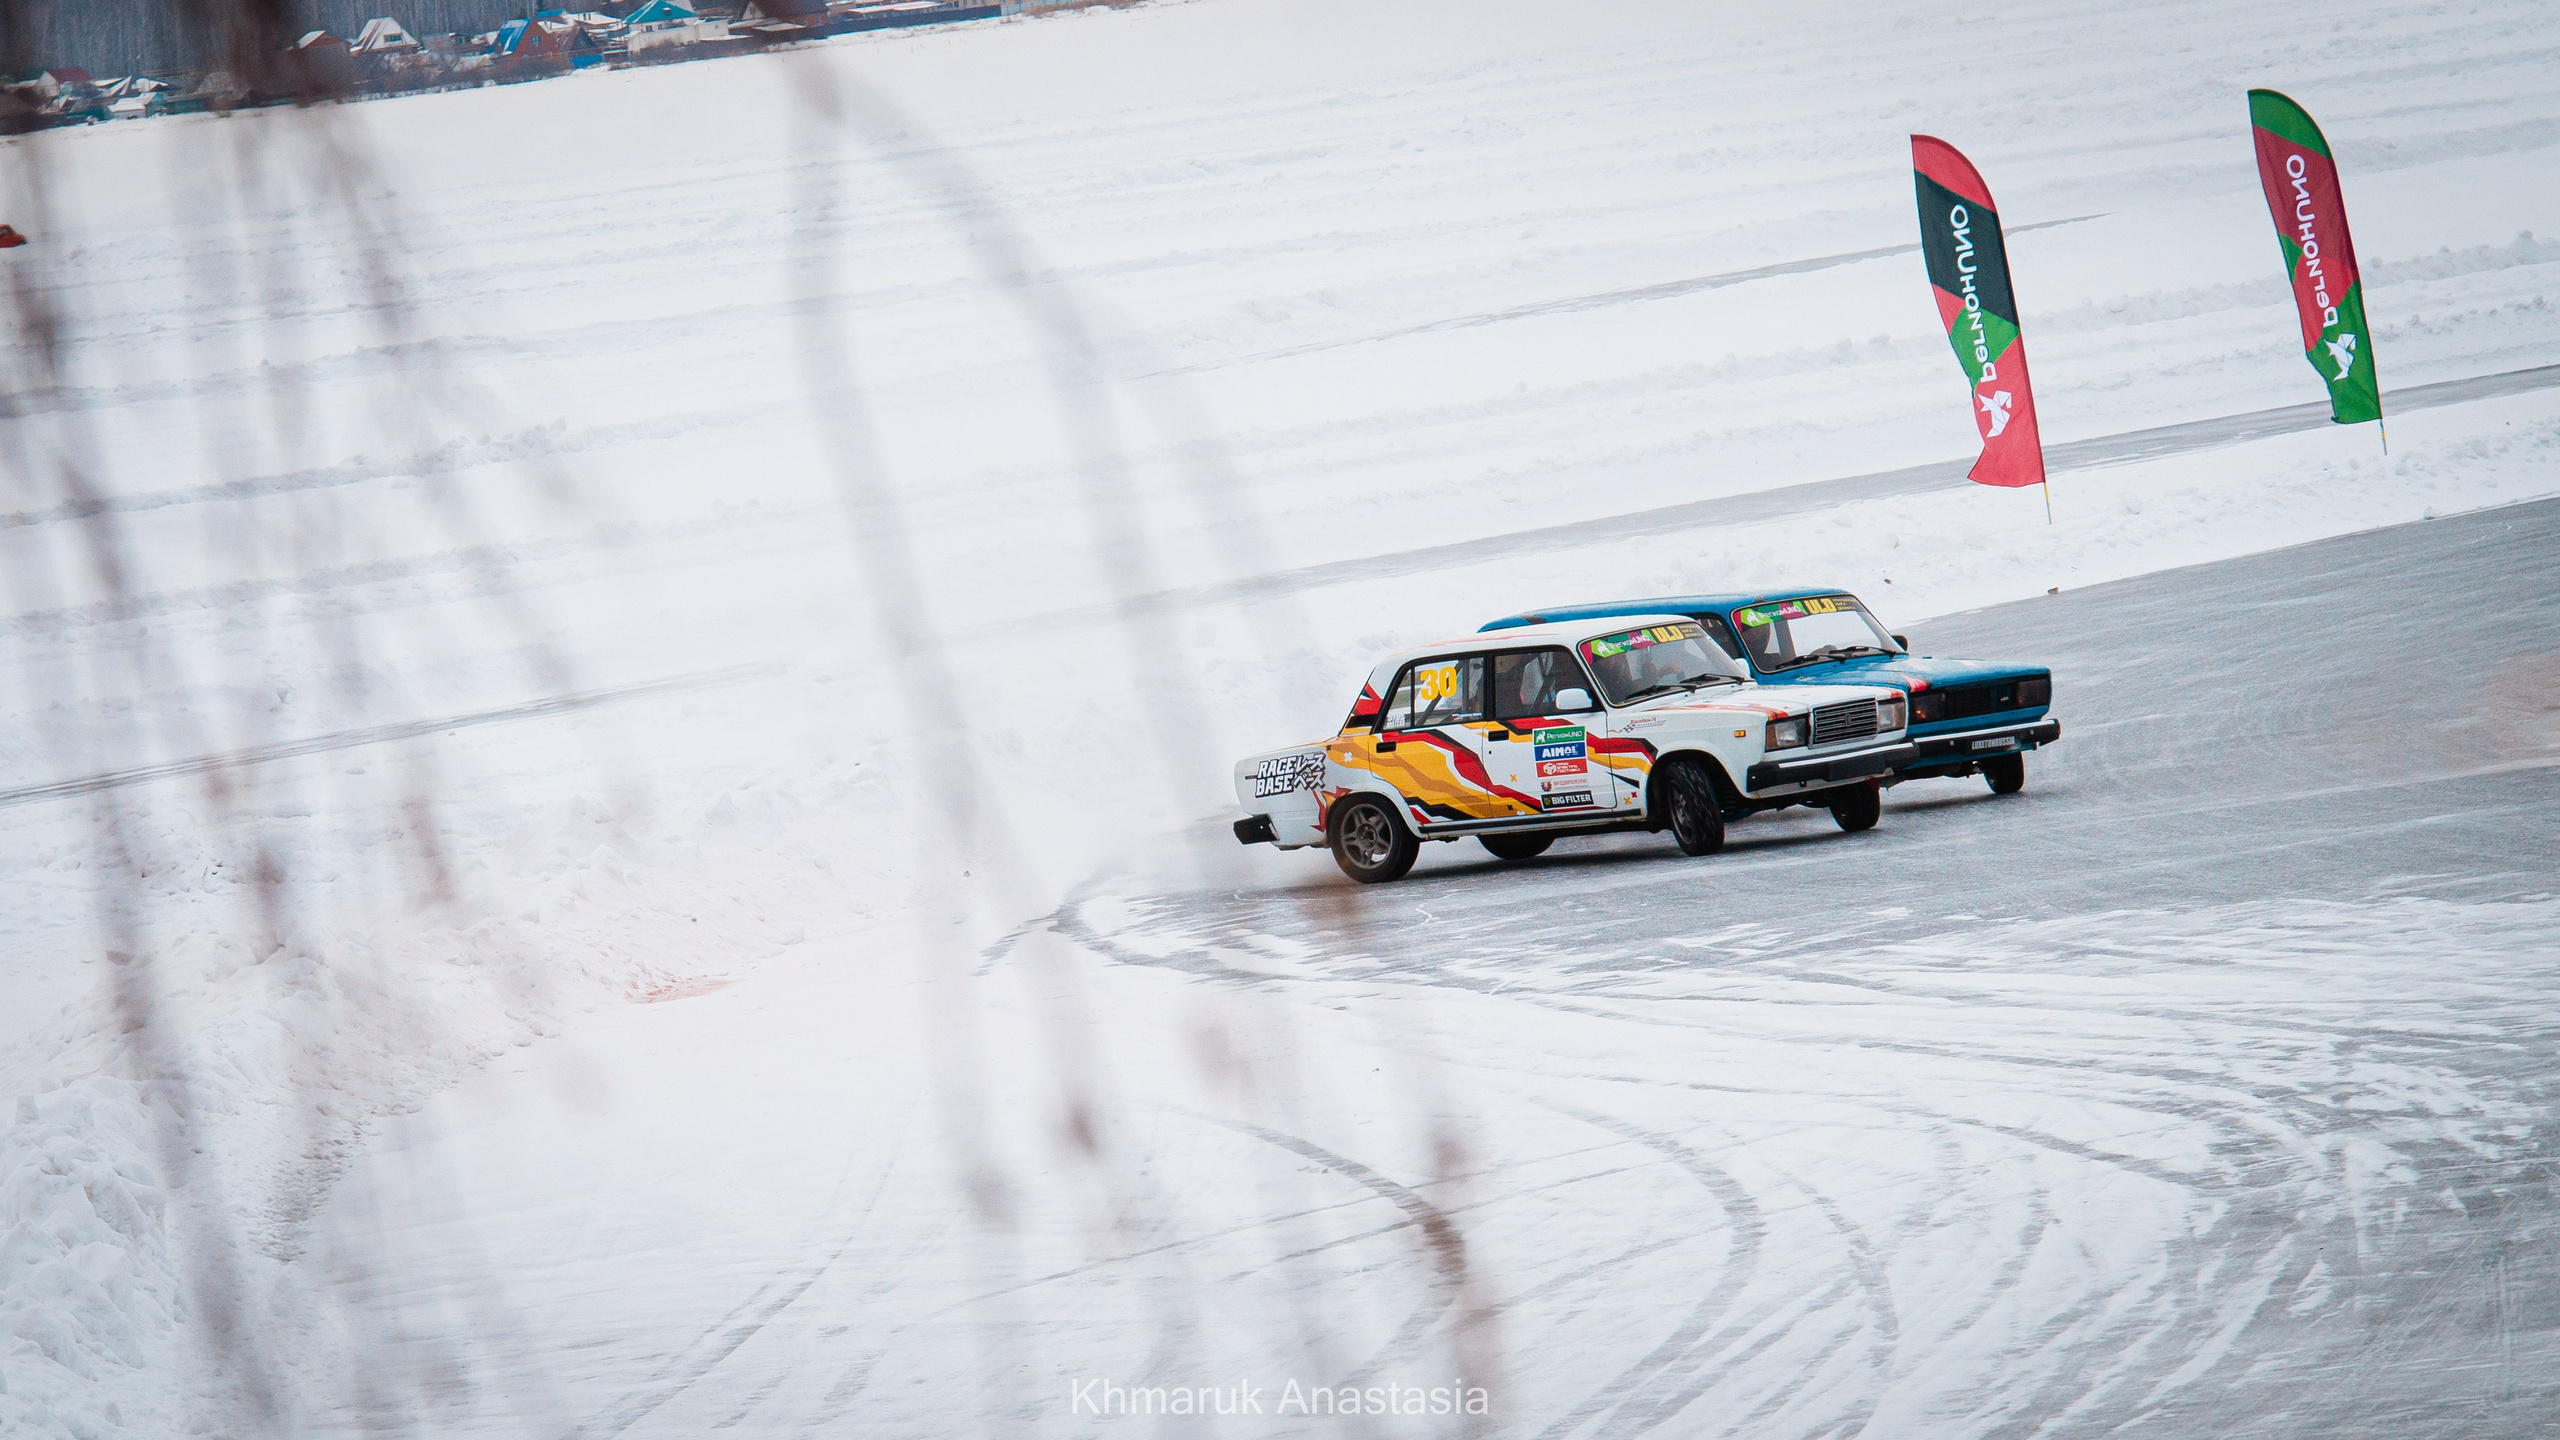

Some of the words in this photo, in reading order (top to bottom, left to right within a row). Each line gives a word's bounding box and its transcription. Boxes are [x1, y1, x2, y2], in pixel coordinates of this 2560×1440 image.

[1804, 598, 1837, 614] ULD
[1651, 625, 1685, 643] ULD
[1420, 666, 1457, 700] 30
[1542, 746, 1577, 758] AIMOL
[1257, 755, 1298, 779] RACE
[1255, 775, 1294, 798] BASE
[1552, 797, 1565, 805] BIG
[1566, 794, 1591, 804] FILTER
